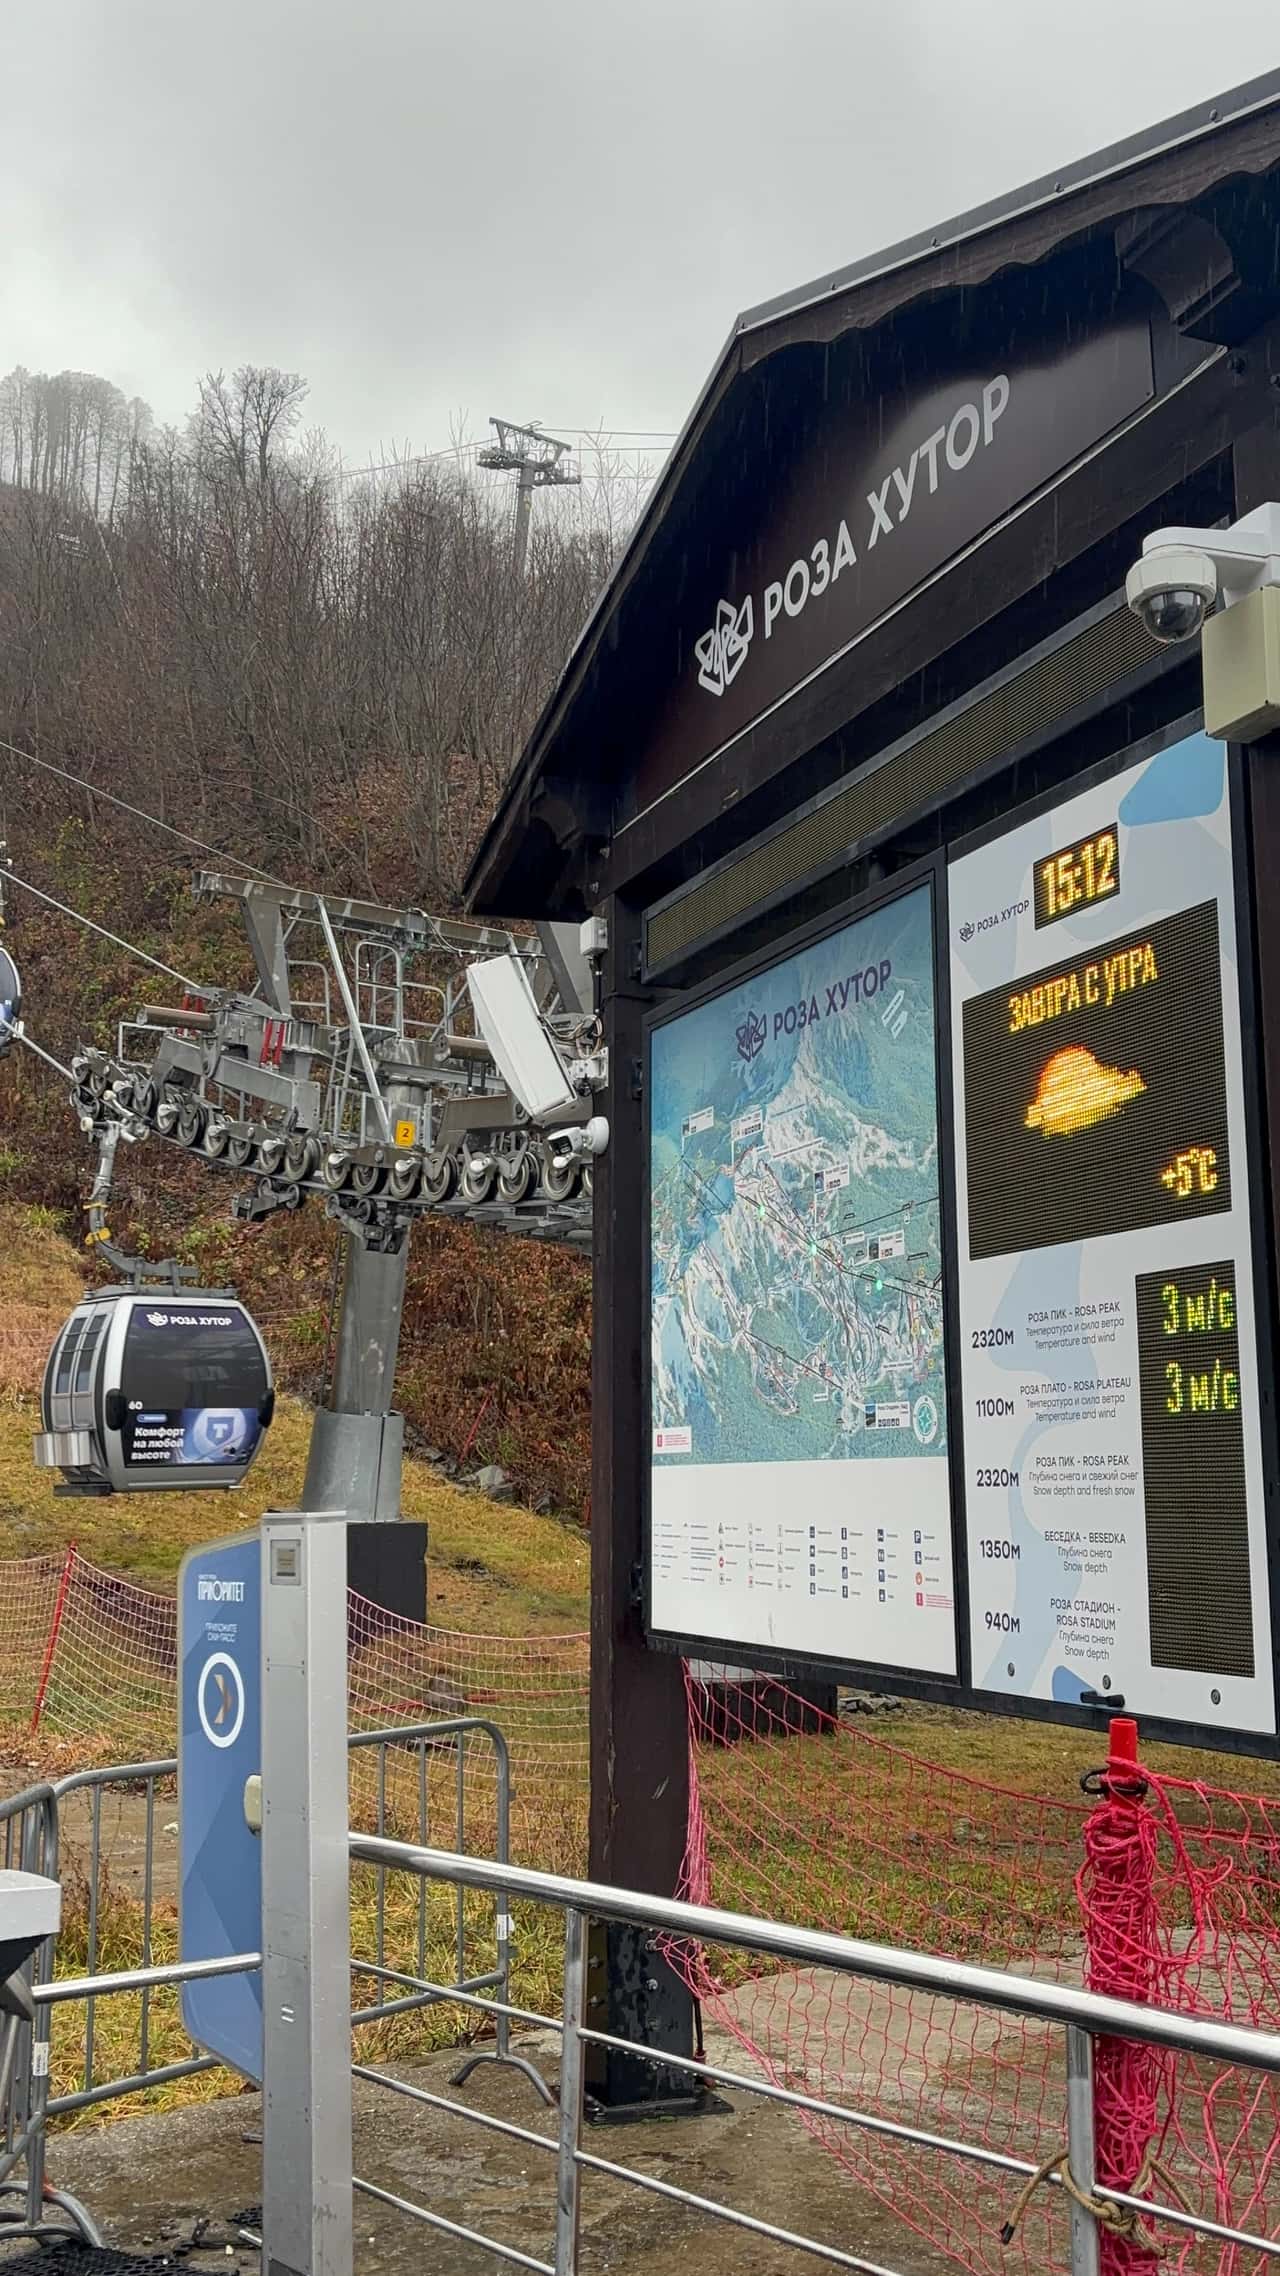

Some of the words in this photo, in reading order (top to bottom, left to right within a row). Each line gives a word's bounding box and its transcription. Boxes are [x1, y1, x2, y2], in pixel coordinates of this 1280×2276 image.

[764, 519, 857, 639] РОЗА
[867, 374, 1010, 550] ХУТОР
[1043, 834, 1115, 915] 15:12
[977, 914, 999, 933] РОЗА
[1001, 900, 1030, 923] ХУТОР
[1008, 973, 1080, 1032] ЗАВТРА
[1085, 966, 1099, 1004] С
[1104, 943, 1158, 1006] УТРА
[774, 996, 820, 1040] РОЗА
[825, 959, 892, 1017] ХУТОР
[402, 1127, 410, 1137] 2
[1028, 1312, 1048, 1324] РОЗА
[1050, 1310, 1067, 1321] ПИК
[1075, 1305, 1096, 1317] ROSA
[1099, 1302, 1120, 1313] PEAK
[1162, 1283, 1179, 1334] 3
[170, 1316, 198, 1325] РОЗА
[199, 1316, 232, 1326] ХУТОР
[1081, 1321, 1099, 1330] сила
[1102, 1317, 1125, 1328] ветра
[1035, 1336, 1080, 1350] Temperature
[1082, 1334, 1096, 1345] and
[1098, 1332, 1115, 1343] wind
[1020, 1383, 1039, 1395] РОЗА
[1041, 1382, 1067, 1394] ПЛАТО
[1074, 1380, 1095, 1391] ROSA
[1097, 1377, 1131, 1390] PLATEAU
[1166, 1361, 1183, 1412] 3
[1102, 1393, 1125, 1405] ветра
[1035, 1410, 1080, 1423] Temperature
[1082, 1408, 1096, 1419] and
[1098, 1408, 1116, 1419] wind
[135, 1427, 185, 1438] Комфорт
[133, 1440, 147, 1448] на
[148, 1438, 184, 1448] любой
[131, 1451, 170, 1460] высоте
[1036, 1456, 1056, 1467] РОЗА
[1059, 1456, 1075, 1467] ПИК
[1083, 1455, 1105, 1466] ROSA
[1108, 1455, 1129, 1466] PEAK
[1029, 1471, 1058, 1483] Глубина
[1059, 1473, 1080, 1481] снега
[1089, 1470, 1118, 1481] свежий
[1120, 1472, 1138, 1481] снег
[1033, 1486, 1052, 1496] Snow
[1054, 1485, 1075, 1498] depth
[1077, 1485, 1091, 1496] and
[1093, 1485, 1113, 1496] fresh
[1115, 1487, 1135, 1496] snow
[1044, 1531, 1080, 1543] БЕСЕДКА
[1089, 1532, 1126, 1544] BESEDKA
[1058, 1546, 1088, 1559] Глубина
[1090, 1549, 1112, 1559] снега
[1063, 1561, 1083, 1572] Snow
[1084, 1562, 1107, 1574] depth
[198, 1581, 245, 1602] ПРИОРИТЕТ
[1050, 1598, 1071, 1610] РОЗА
[1074, 1600, 1115, 1614] СТАДИОН
[1056, 1616, 1078, 1627] ROSA
[1081, 1617, 1116, 1630] STADIUM
[1059, 1630, 1090, 1644] Глубина
[1091, 1634, 1114, 1646] снега
[1064, 1645, 1085, 1657] Snow
[1086, 1647, 1110, 1661] depth
